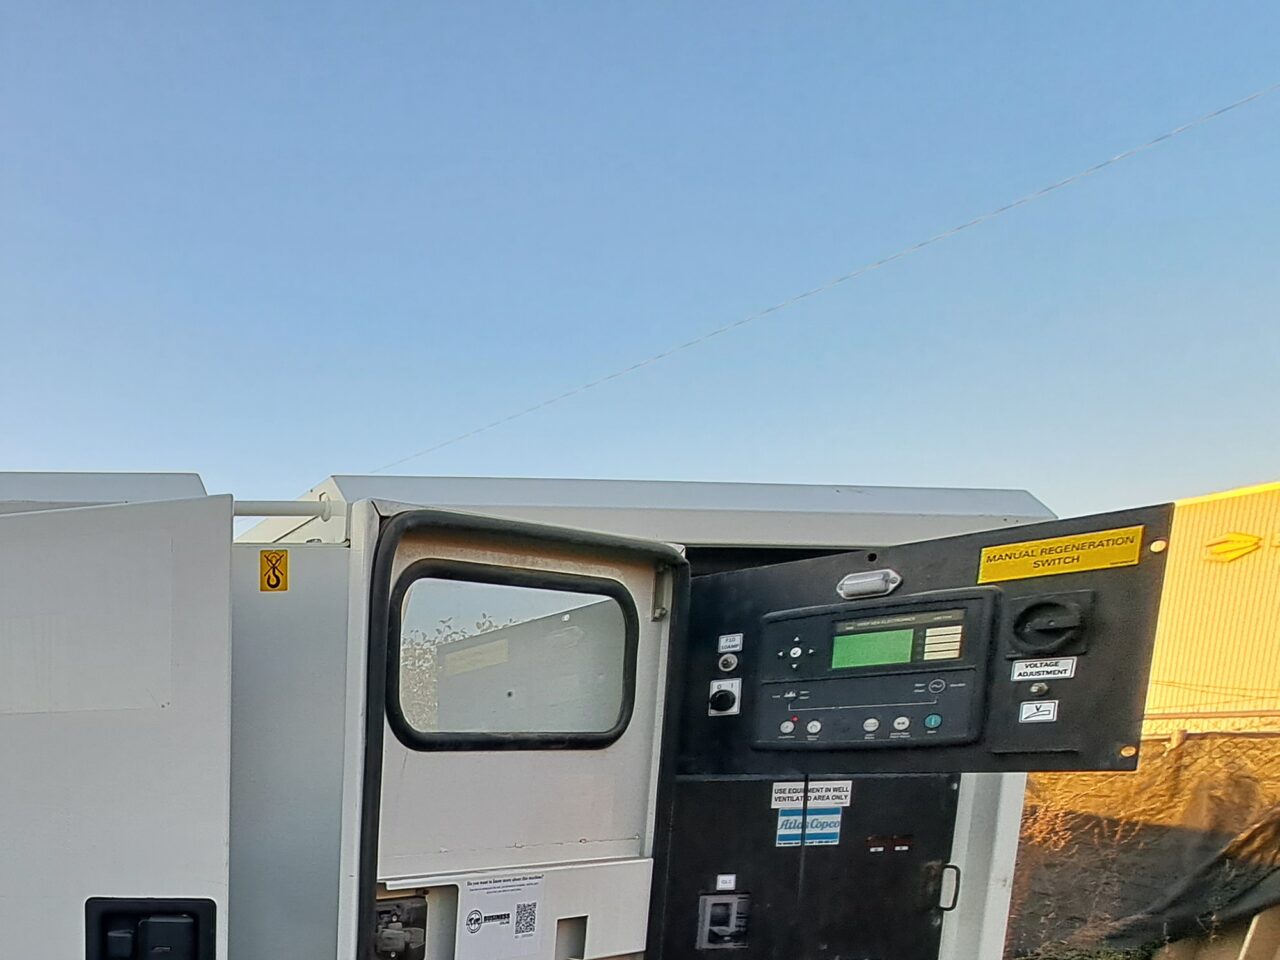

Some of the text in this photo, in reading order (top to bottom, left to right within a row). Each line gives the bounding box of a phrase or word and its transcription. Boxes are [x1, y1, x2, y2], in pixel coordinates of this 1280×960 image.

[986, 536, 1135, 563] MANUAL REGENERATION
[1033, 555, 1080, 568] SWITCH
[1017, 669, 1068, 677] ADJUSTMENT
[774, 787, 786, 795] USE
[810, 818, 840, 830] Copco
